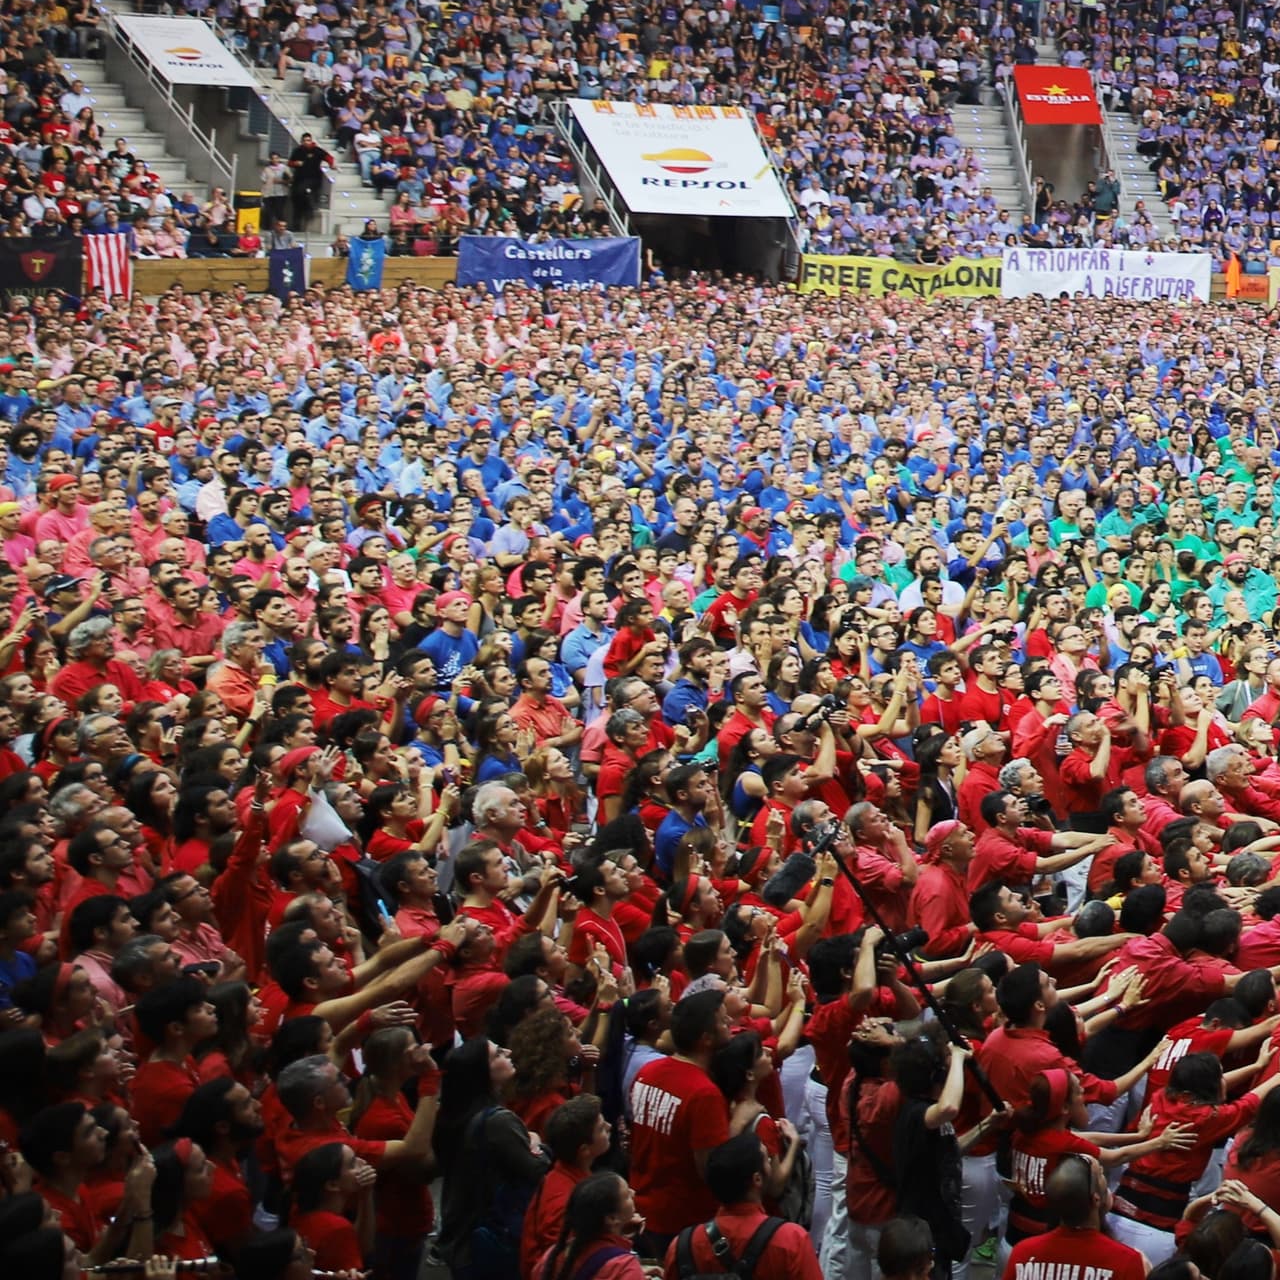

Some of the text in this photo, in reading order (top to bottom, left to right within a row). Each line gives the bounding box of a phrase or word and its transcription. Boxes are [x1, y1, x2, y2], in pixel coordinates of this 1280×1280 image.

[168, 61, 224, 69] REPSOL
[1025, 94, 1090, 102] ESTRELLA
[642, 177, 752, 190] REPSOL
[504, 245, 592, 260] Castellers
[31, 258, 46, 273] T
[1007, 252, 1019, 271] A
[533, 267, 562, 277] de la
[803, 263, 1001, 296] FREE CATALONI
[1085, 275, 1093, 295] A
